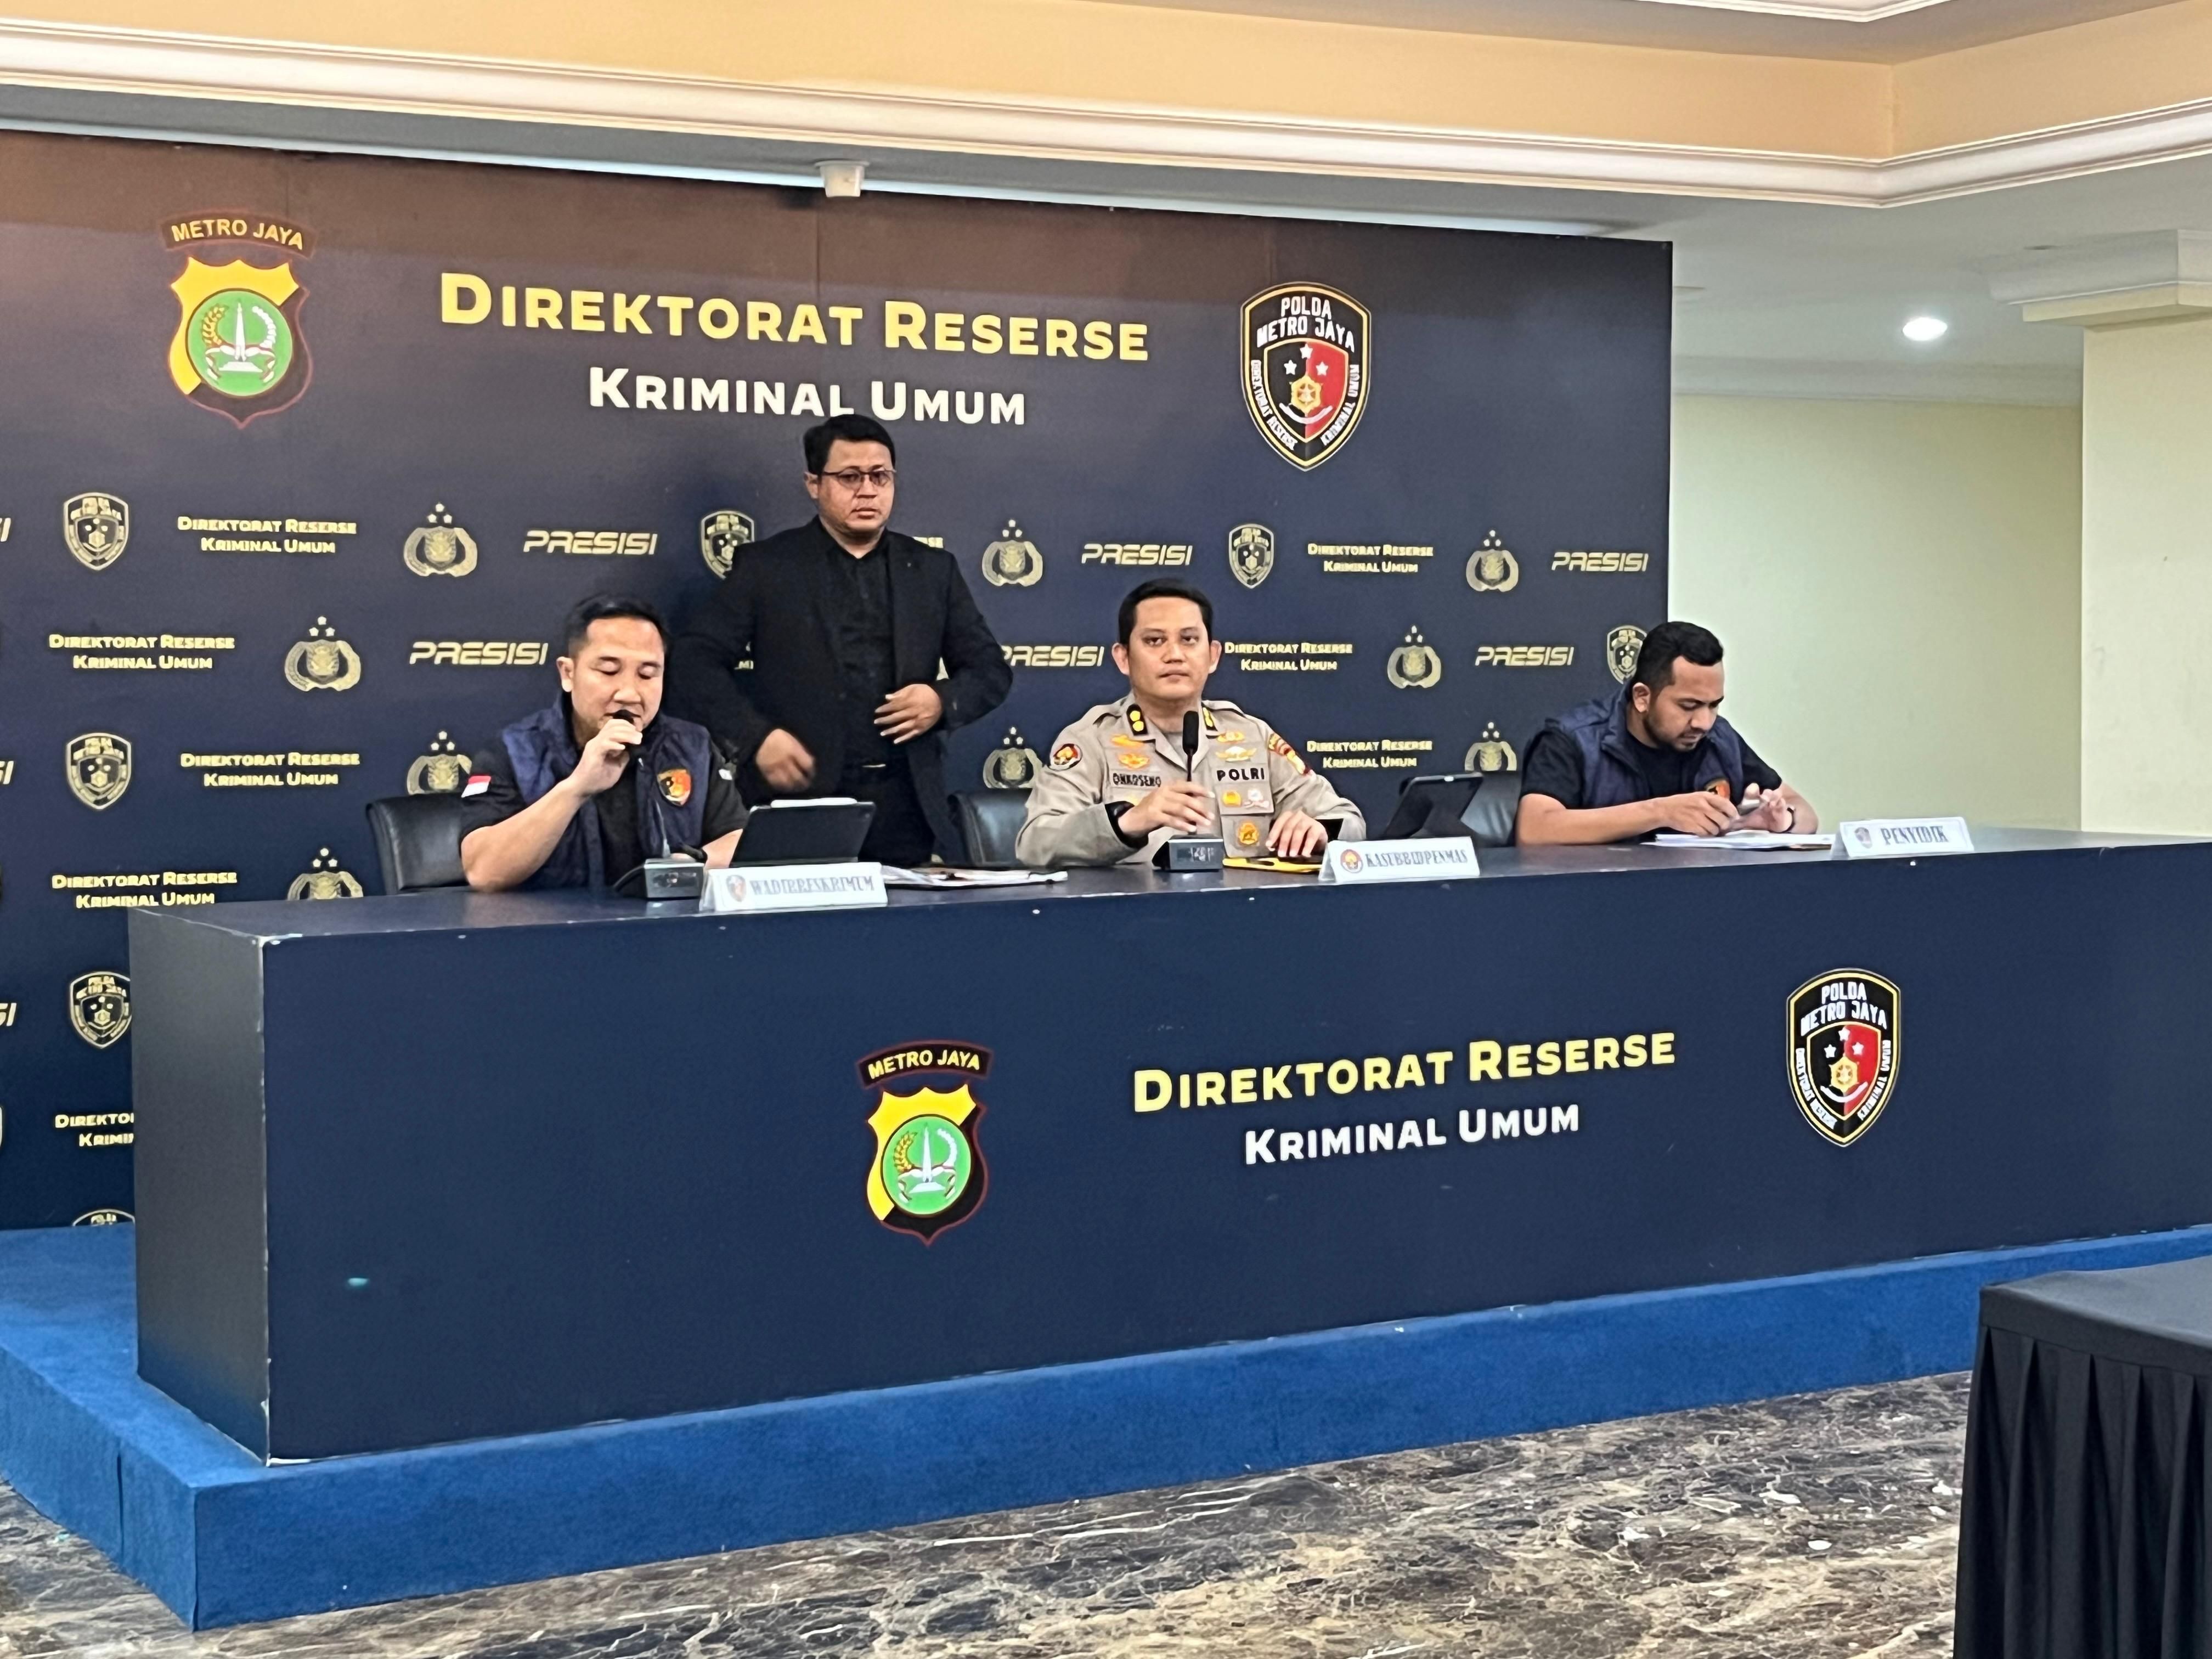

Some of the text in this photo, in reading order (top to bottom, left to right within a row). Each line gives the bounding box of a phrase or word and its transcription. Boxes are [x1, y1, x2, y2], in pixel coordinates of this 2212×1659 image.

[172, 219, 302, 250] METRO JAYA
[442, 273, 1148, 360] DIREKTORAT RESERSE
[1280, 296, 1331, 319] POLDA
[1314, 317, 1355, 353] JAYA
[590, 367, 1024, 425] KRIMINAL UMUM
[178, 517, 356, 534] DIREKTORAT RESERSE
[201, 538, 335, 553] KRIMINAL UMUM
[523, 531, 657, 555] PRESISI
[1308, 544, 1380, 555] DIREKTORAT
[1082, 544, 1192, 565] PRESISI
[1552, 552, 1648, 571] PRESISI
[1324, 561, 1418, 572] KRIMINAL UMUM
[49, 634, 235, 648] DIREKTORAT RESERSE
[1225, 642, 1299, 653] DIREKTORAT
[410, 642, 548, 664] PRESISI
[1475, 647, 1574, 665] PRESISI
[74, 656, 212, 669] KRIMINAL UMUM
[1241, 659, 1337, 670] KRIMINAL UMUM
[1307, 741, 1379, 752] DIREKTORAT
[181, 752, 360, 767] DIREKTORAT RESERSE
[1323, 757, 1417, 768] KRIMINAL UMUM
[204, 772, 338, 786] KRIMINAL UMUM
[1217, 768, 1265, 781] POLRI
[1880, 826, 1949, 845] PENYIDIK
[52, 872, 237, 888] DIREKTORAT RESERSE
[76, 892, 215, 909] KRIMINAL UMUM
[1821, 981, 1867, 1004] POLDA
[1852, 1001, 1887, 1030] JAYA
[868, 1050, 979, 1079] METRO JAYA
[1135, 1033, 1674, 1112] DIREKTORAT RESERSE
[1246, 1105, 1578, 1164] KRIMINAL UMUM
